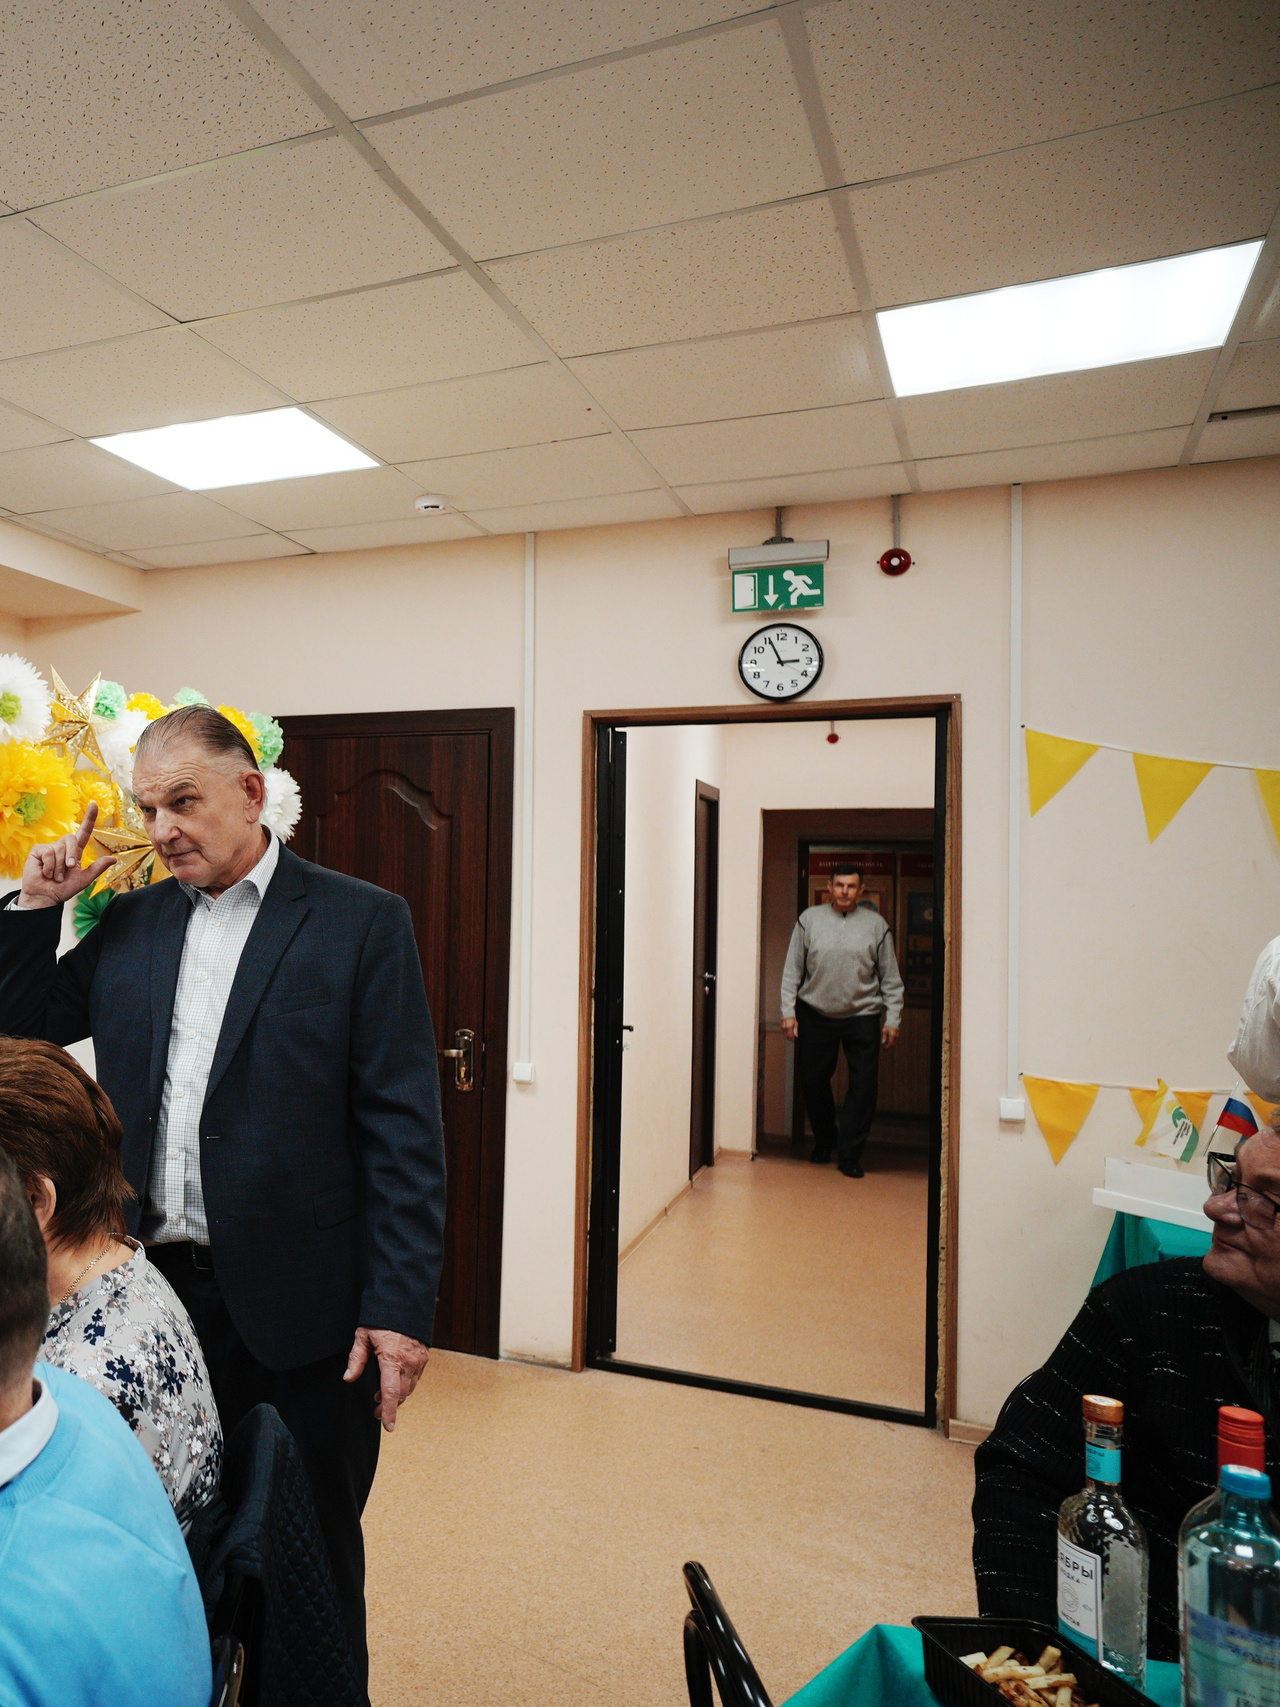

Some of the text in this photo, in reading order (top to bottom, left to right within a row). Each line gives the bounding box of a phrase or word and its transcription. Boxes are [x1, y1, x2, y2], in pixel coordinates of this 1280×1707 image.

[776, 633, 788, 641] 12
[794, 636, 798, 644] 1
[753, 646, 765, 654] 10
[801, 644, 809, 652] 2
[805, 657, 813, 665] 3
[753, 671, 760, 679] 8
[763, 680, 770, 688] 7
[776, 683, 784, 691] 6
[790, 679, 798, 688] 5
